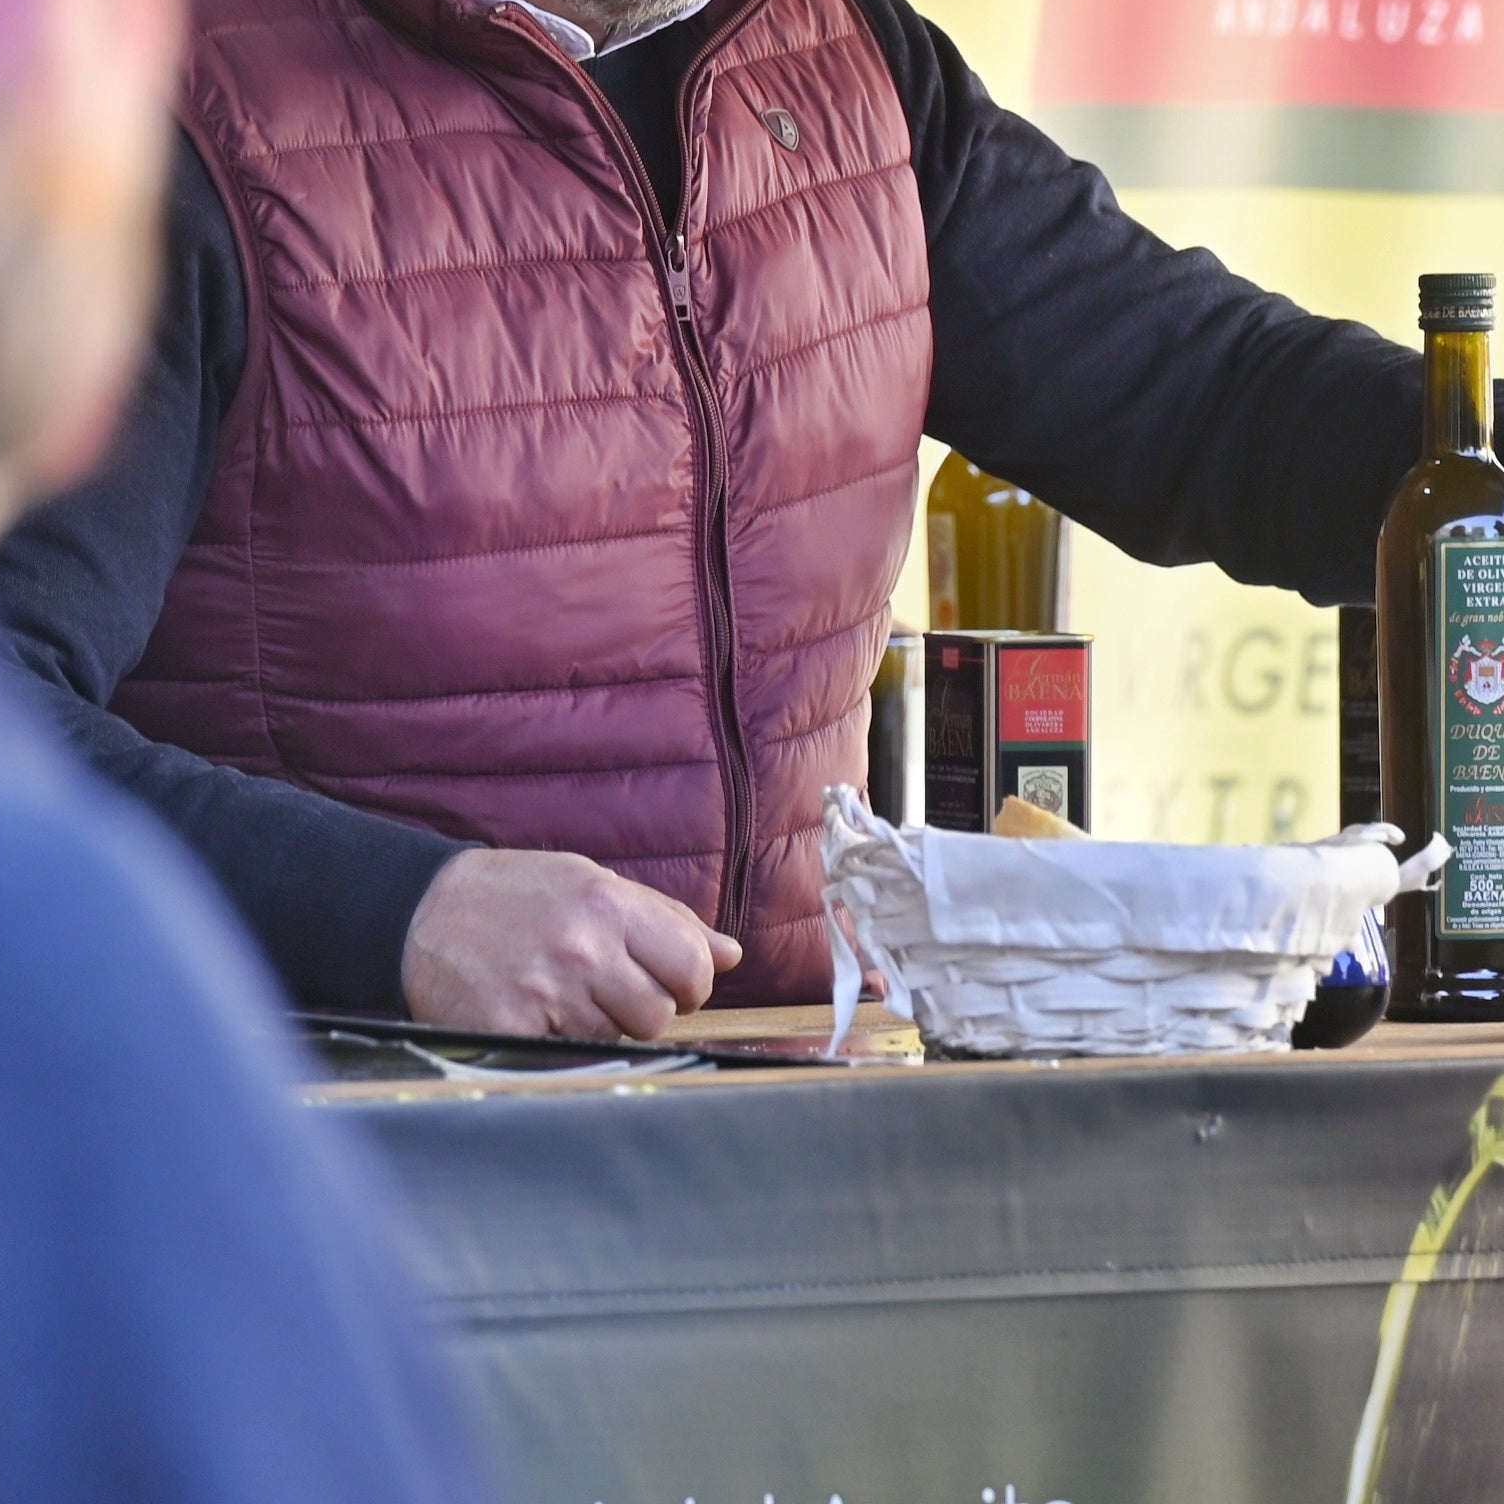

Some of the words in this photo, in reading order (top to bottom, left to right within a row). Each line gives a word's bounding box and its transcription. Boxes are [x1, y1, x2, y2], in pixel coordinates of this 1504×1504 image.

[1457, 569, 1474, 580] DE
[1472, 744, 1501, 761] DE
[1470, 880, 1494, 891] 500
